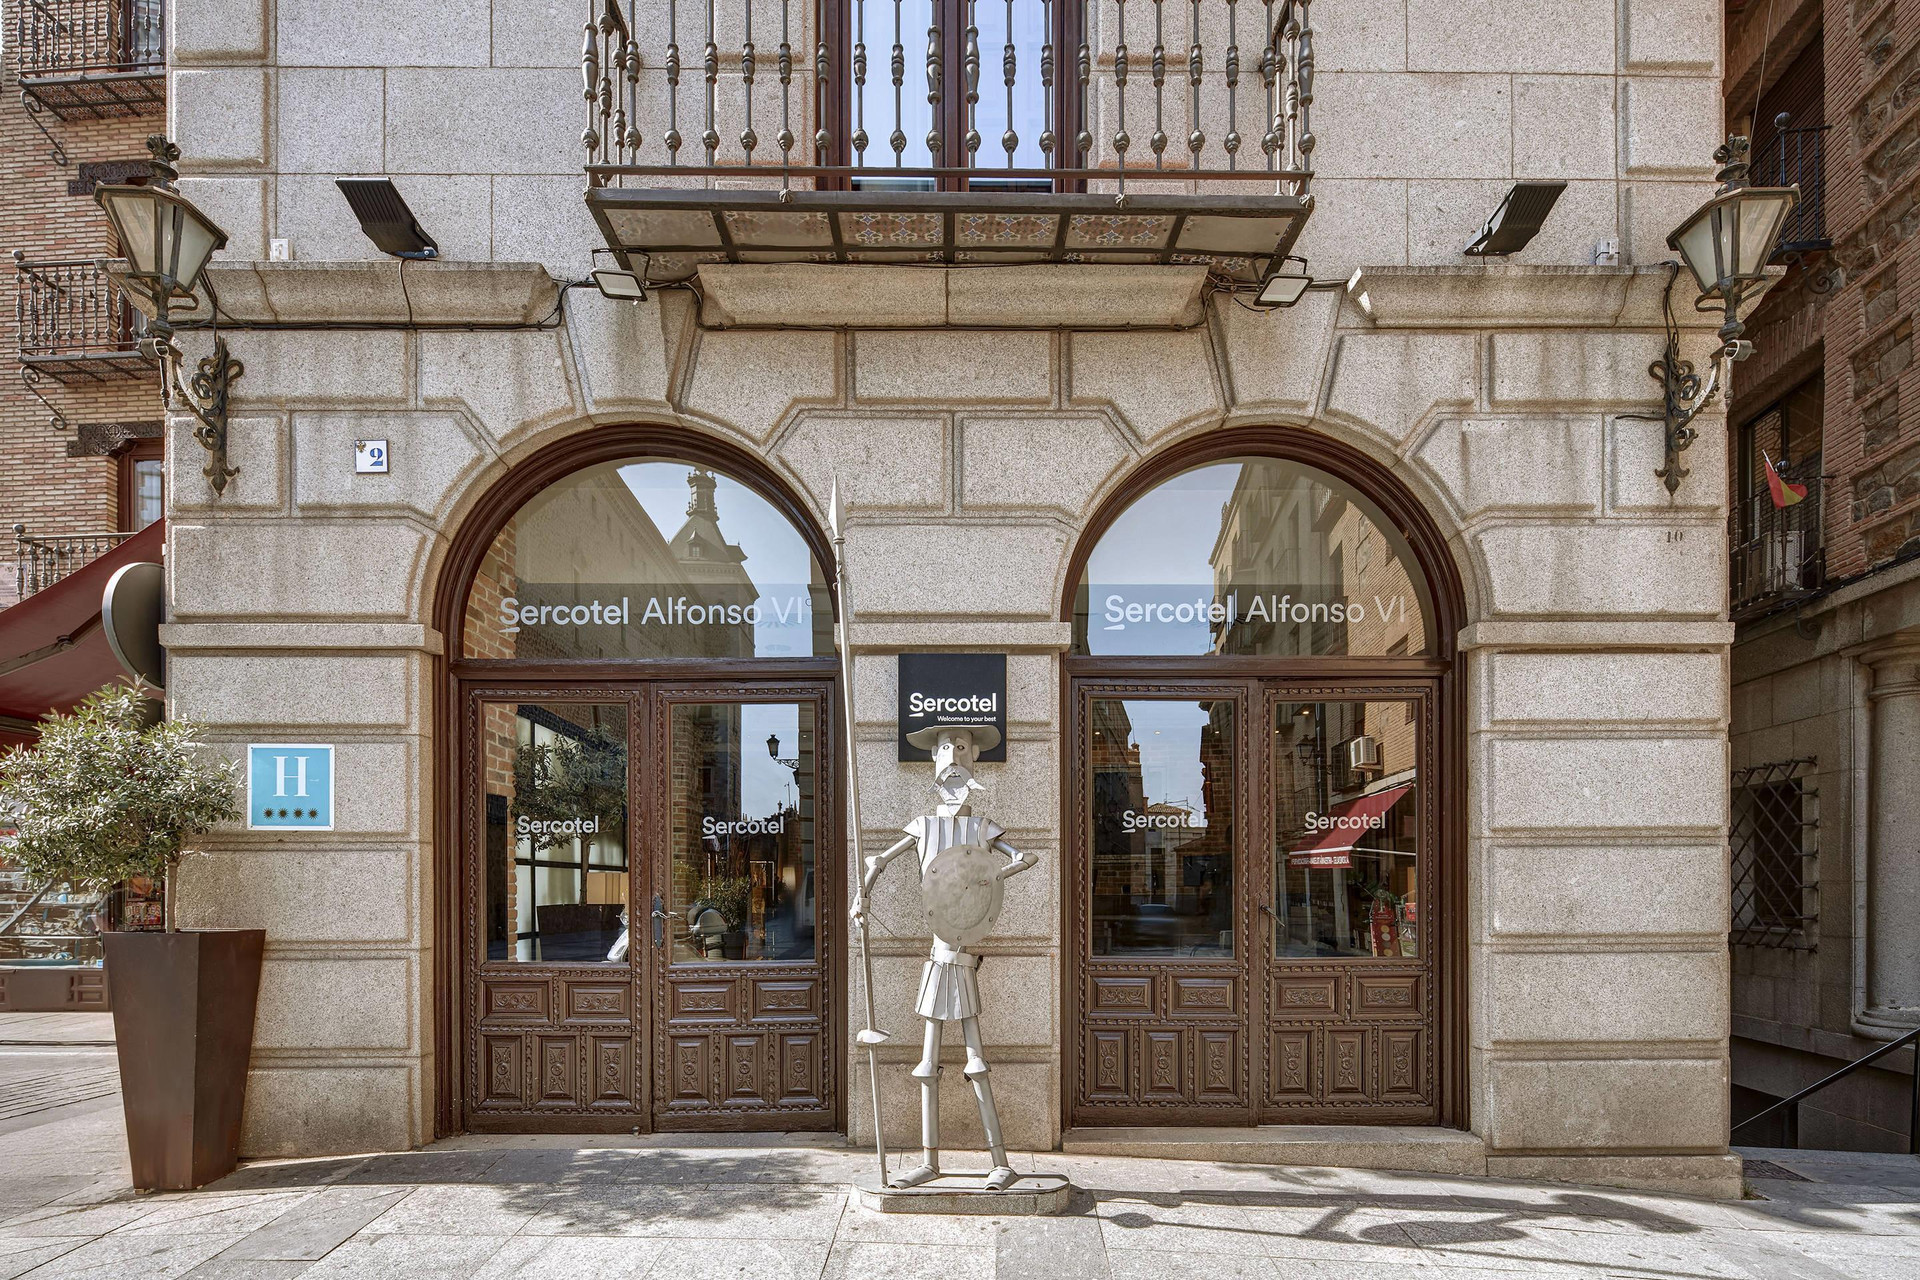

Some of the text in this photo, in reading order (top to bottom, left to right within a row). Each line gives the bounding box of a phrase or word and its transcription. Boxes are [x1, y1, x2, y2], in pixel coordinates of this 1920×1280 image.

[369, 447, 384, 467] 2
[499, 596, 803, 633] Sercotel Alfonso VI
[1103, 594, 1405, 631] Sercotel Alfonso VI
[908, 692, 997, 718] Sercotel
[272, 755, 311, 797] H
[517, 815, 599, 839] Sercotel
[702, 816, 785, 839] Sercotel
[1122, 810, 1204, 833] Sercotel
[1304, 811, 1386, 835] Sercotel
